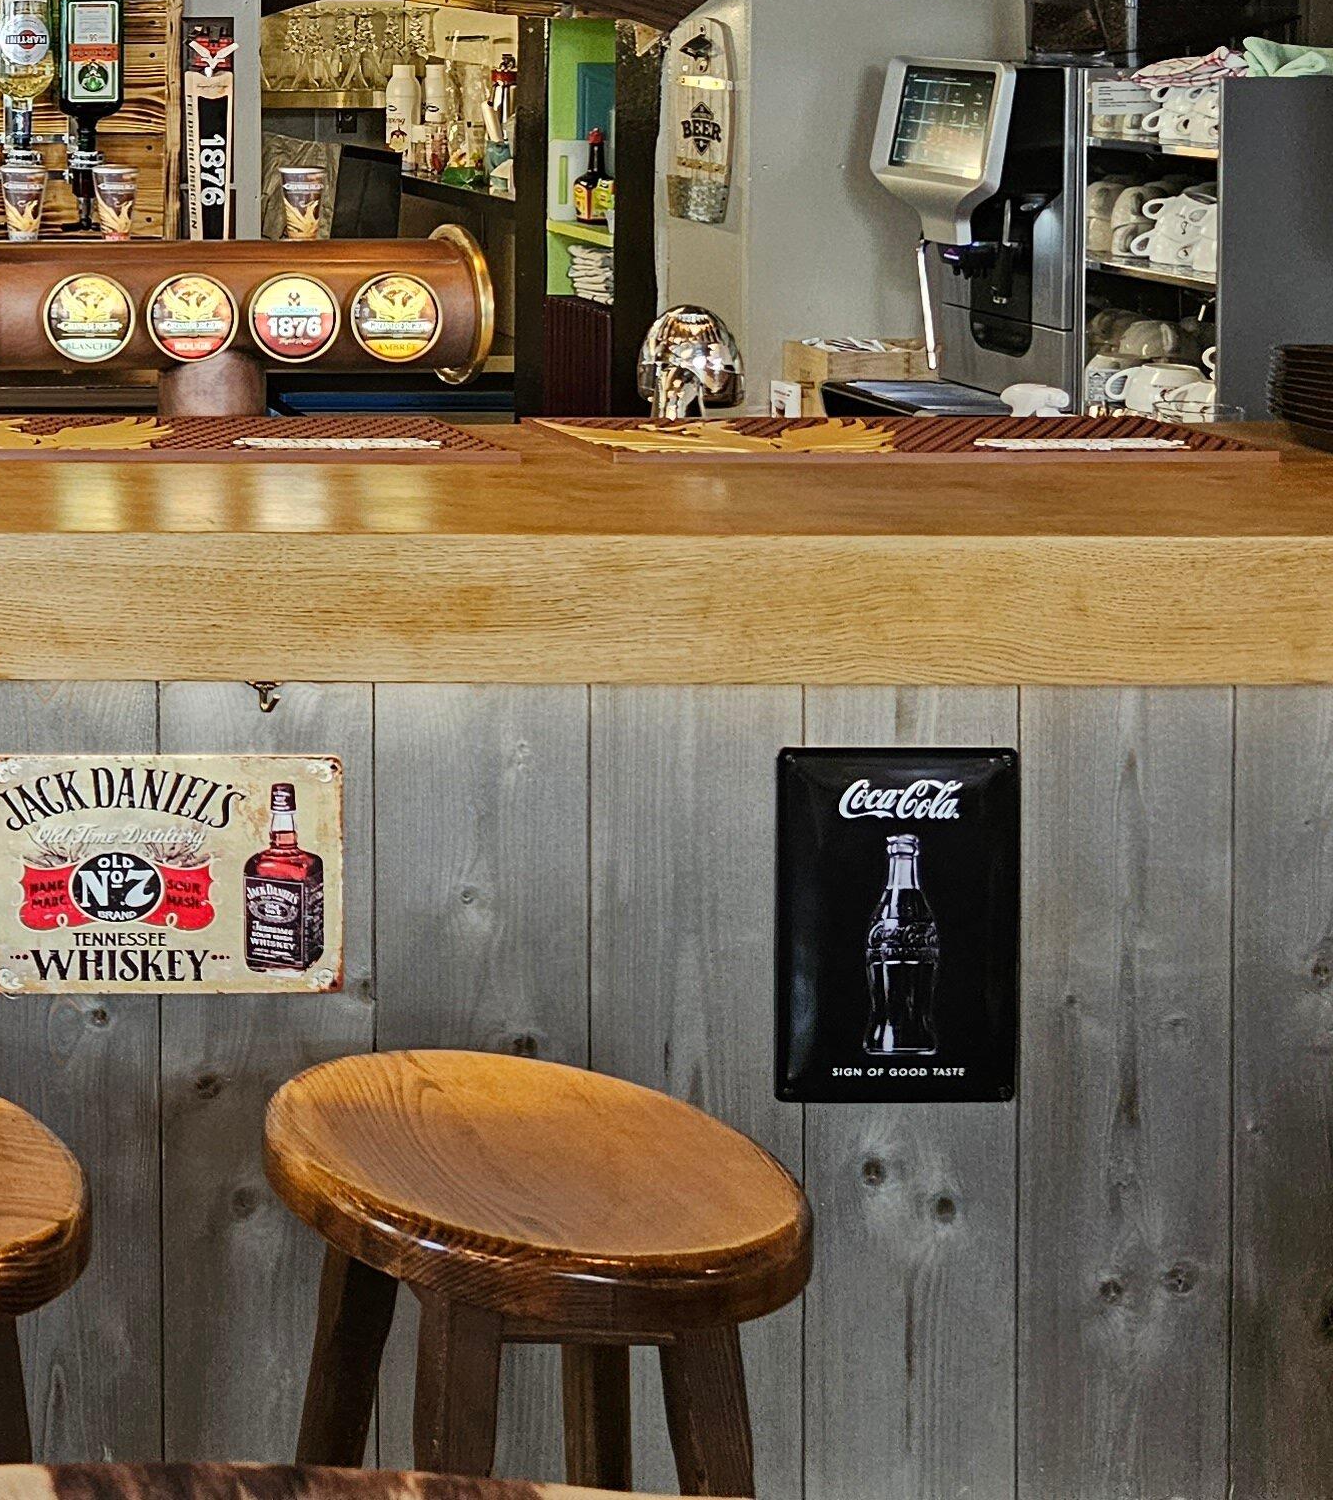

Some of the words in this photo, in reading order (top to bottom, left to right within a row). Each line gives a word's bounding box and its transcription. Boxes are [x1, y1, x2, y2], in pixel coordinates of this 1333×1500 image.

[6, 35, 47, 44] MARTINI
[681, 119, 722, 143] BEER
[200, 133, 226, 206] 1876
[266, 316, 323, 338] 1876
[90, 767, 246, 829] DANIEL'S
[838, 779, 964, 820] Coca-Cola
[35, 825, 71, 845] Old
[74, 823, 116, 846] Time
[98, 856, 134, 869] OLD
[166, 880, 202, 894] SOUR
[98, 910, 137, 920] BRAND
[73, 932, 167, 947] TENNESSEE
[250, 937, 296, 951] WHISKEY
[29, 949, 210, 982] WHISKEY
[832, 1067, 862, 1078] SIGN
[866, 1067, 884, 1078] OF
[889, 1067, 928, 1078] GOOD
[933, 1067, 966, 1078] TASTE
